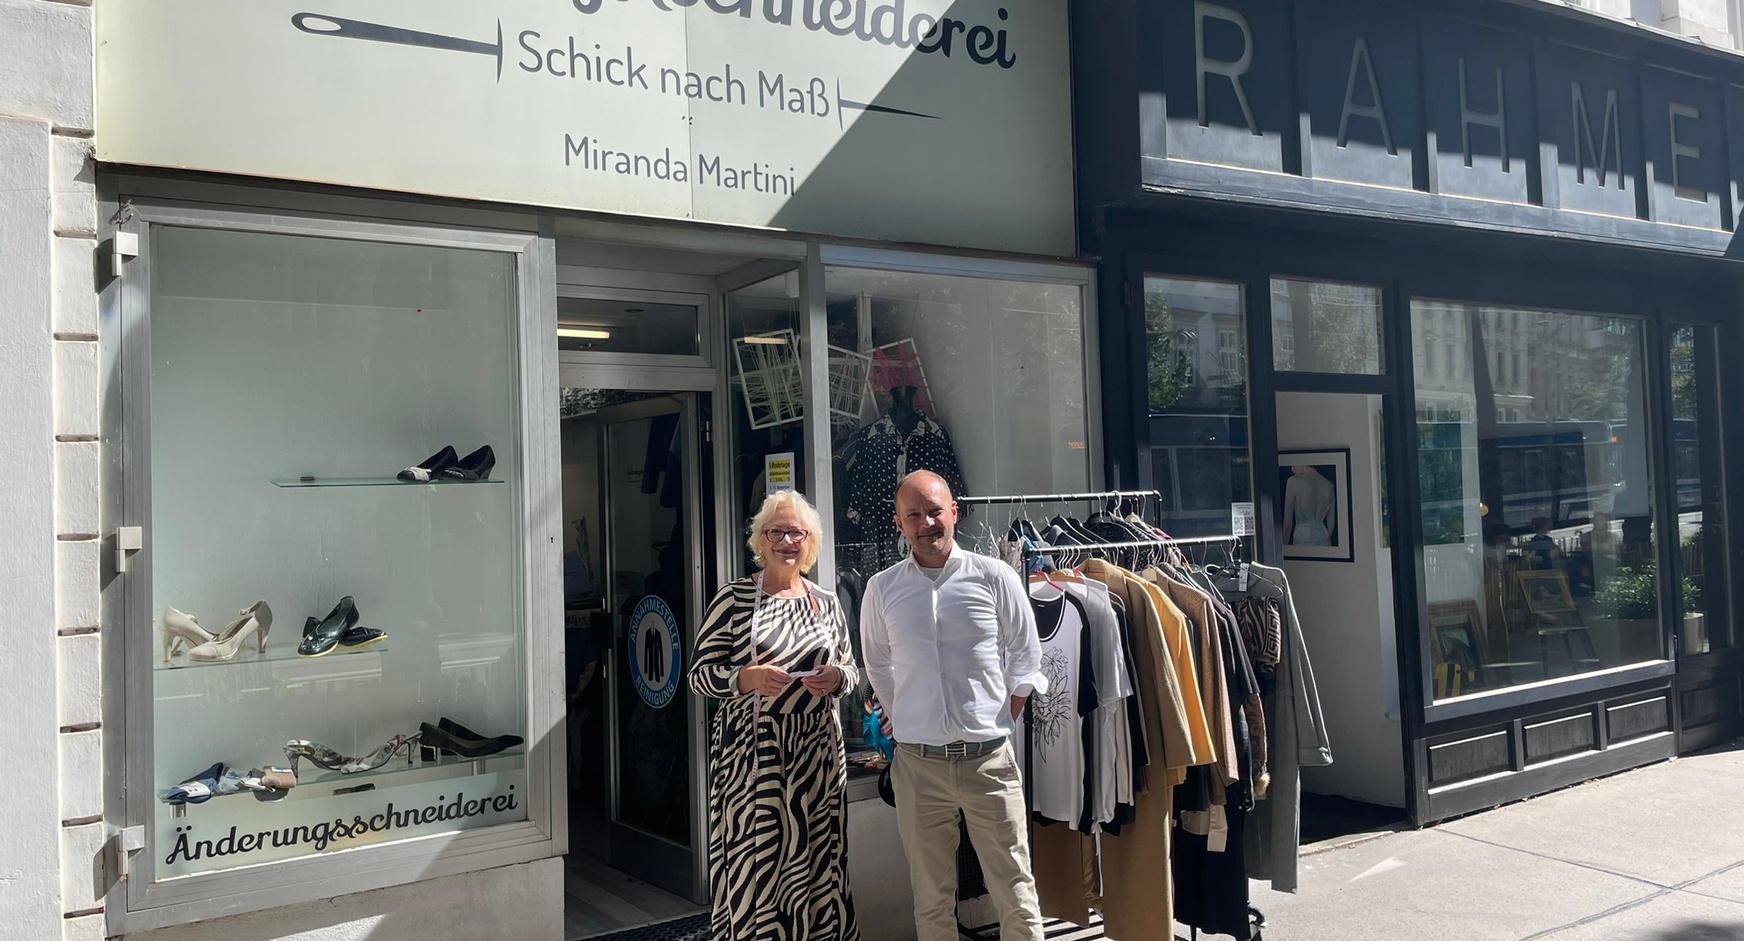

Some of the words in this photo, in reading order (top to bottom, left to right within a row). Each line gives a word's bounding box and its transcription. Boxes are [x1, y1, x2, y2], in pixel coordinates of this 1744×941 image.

[518, 29, 649, 90] Schick
[660, 63, 746, 105] nach
[758, 70, 830, 117] Maß
[1193, 0, 1708, 204] RAHME
[564, 133, 688, 183] Miranda
[698, 153, 796, 197] Martini
[630, 598, 680, 651] ANNAHMESTELLE
[635, 675, 675, 705] REINIGUNG
[165, 784, 519, 865] Änderungsschneiderei
